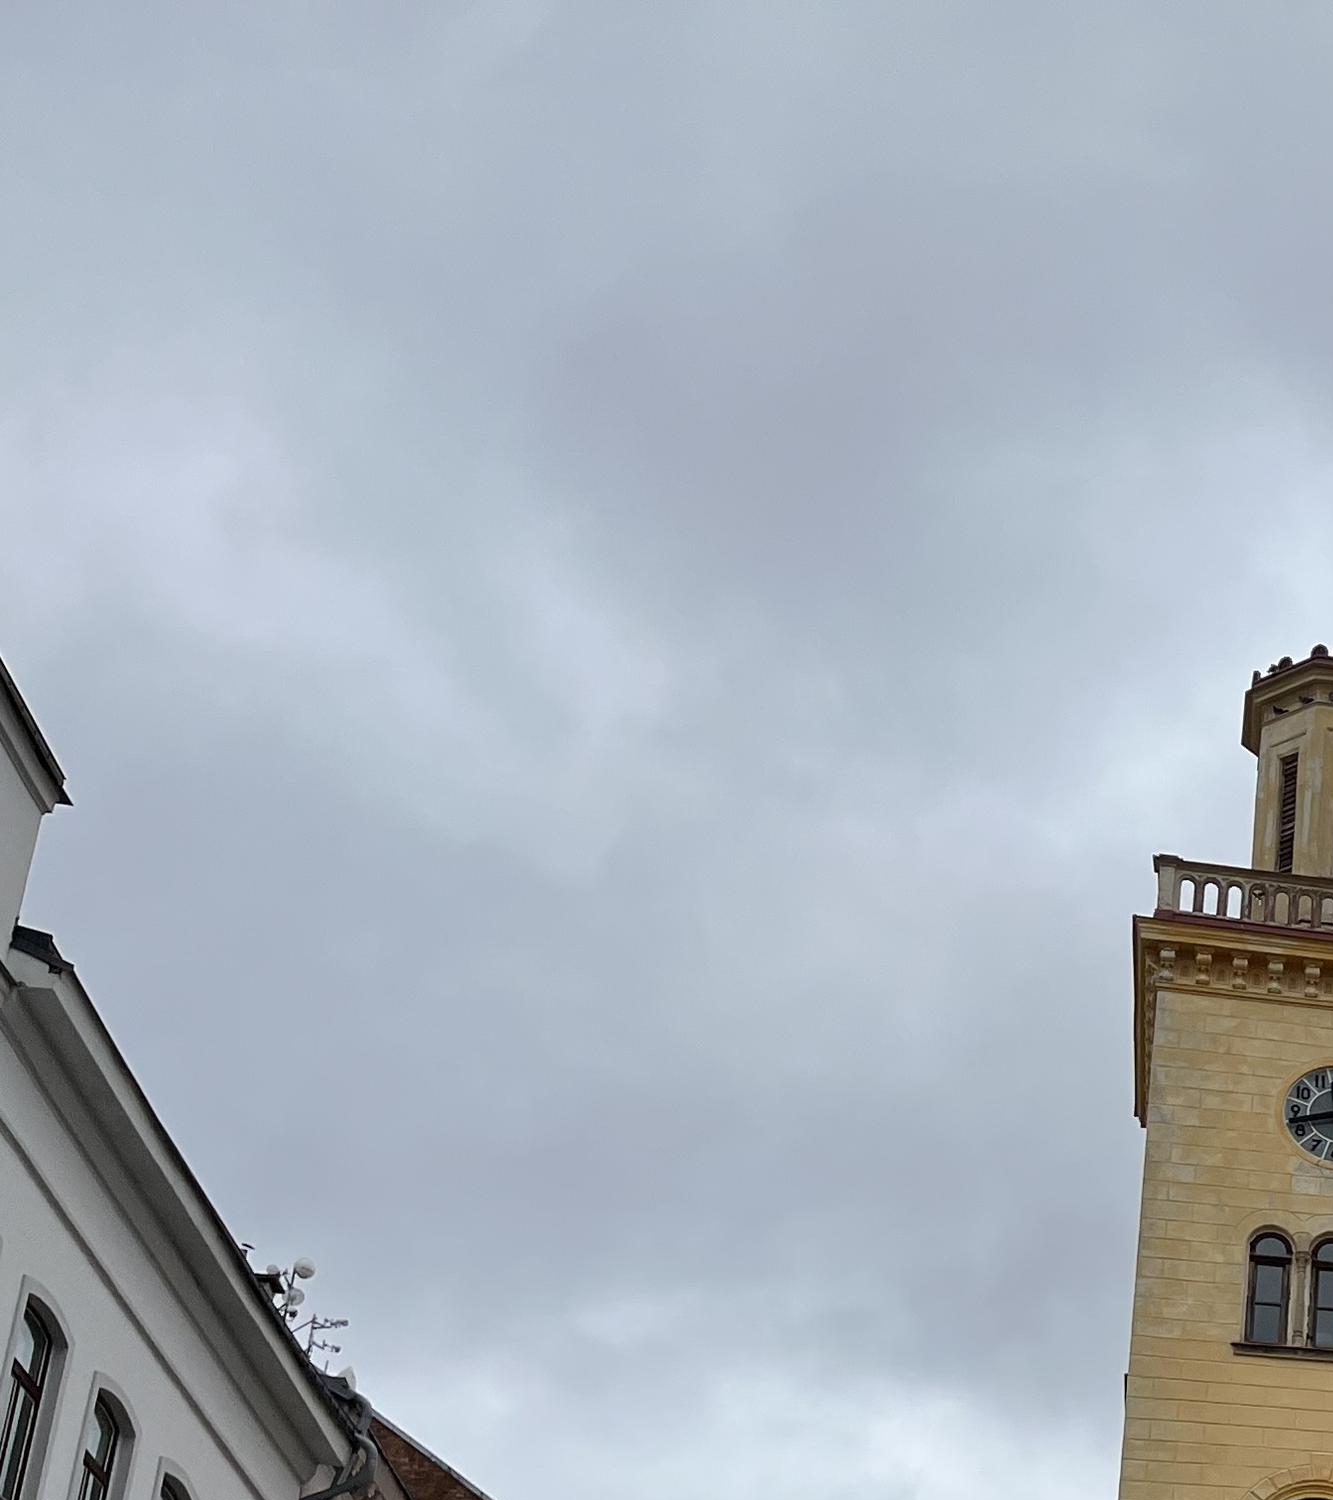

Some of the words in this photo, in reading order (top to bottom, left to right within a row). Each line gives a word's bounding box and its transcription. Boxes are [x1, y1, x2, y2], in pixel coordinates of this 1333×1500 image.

[1315, 1075, 1325, 1088] 11
[1296, 1086, 1311, 1099] 10
[1291, 1104, 1300, 1117] 9
[1295, 1124, 1306, 1136] 8
[1311, 1139, 1322, 1151] 7
